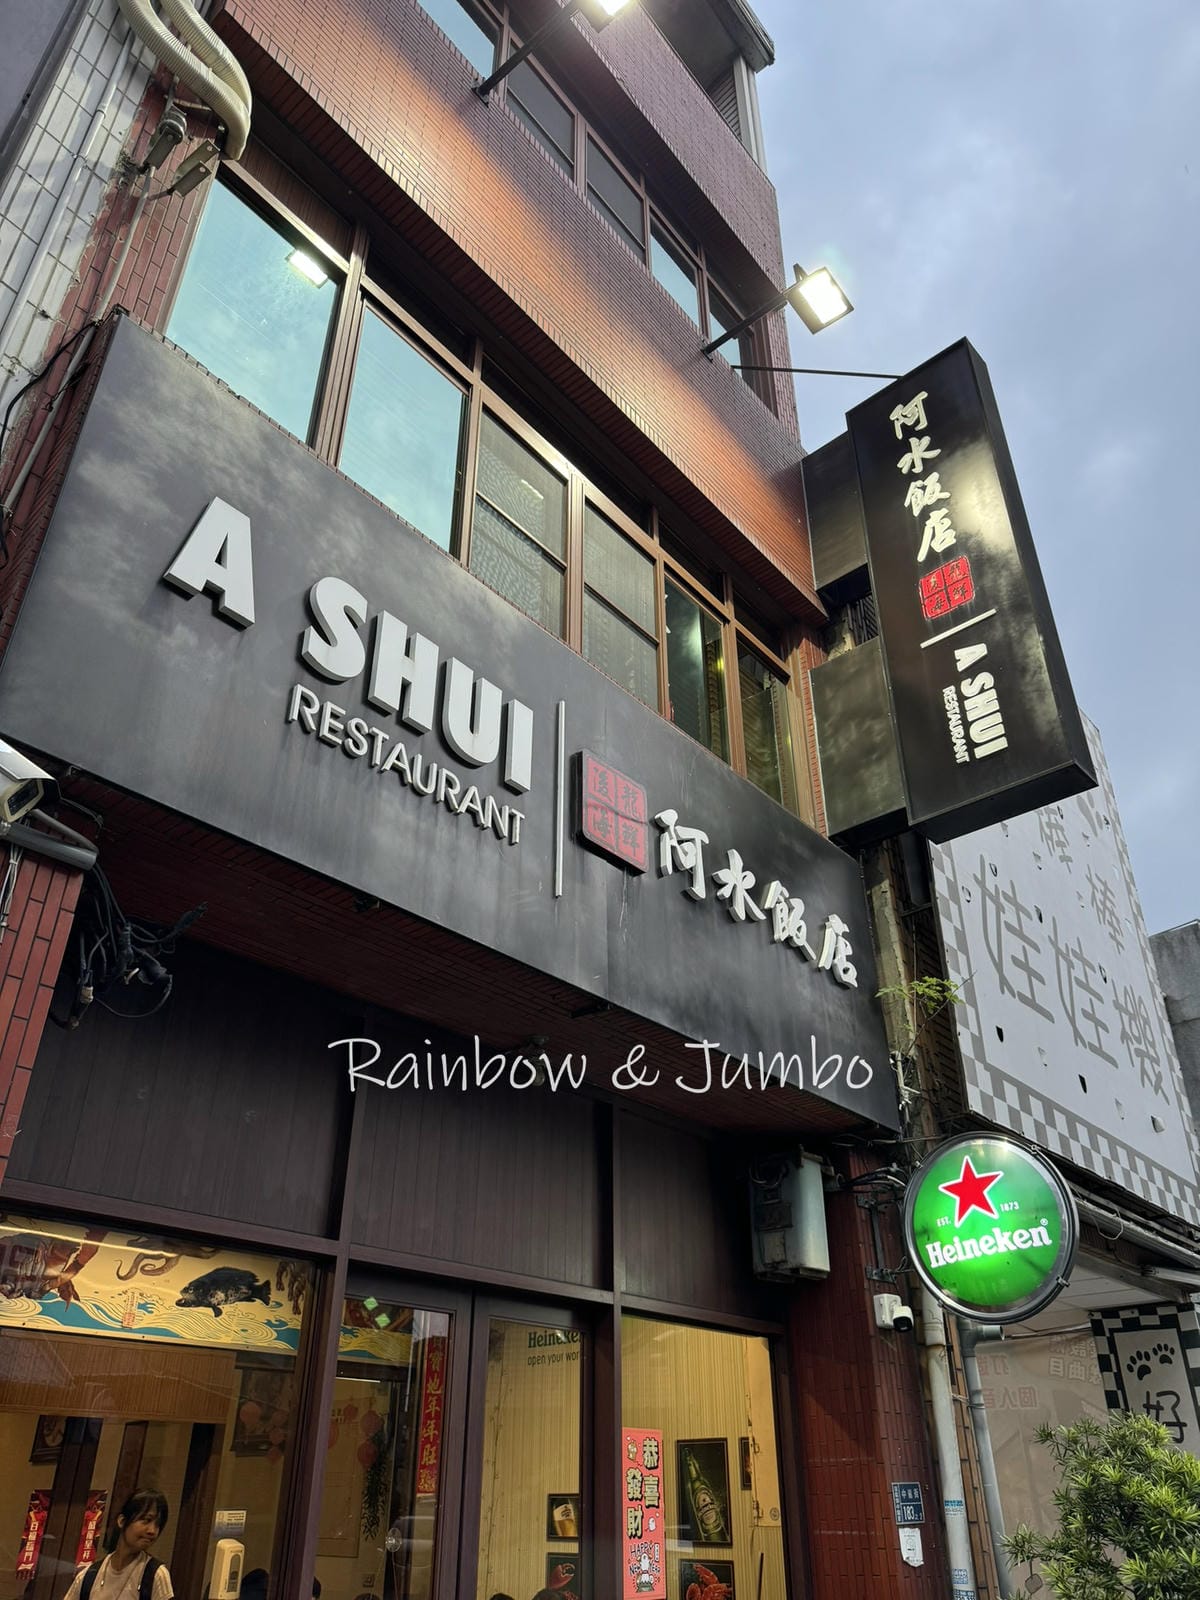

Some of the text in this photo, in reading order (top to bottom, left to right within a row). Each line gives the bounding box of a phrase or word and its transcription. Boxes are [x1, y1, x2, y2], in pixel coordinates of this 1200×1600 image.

[890, 391, 957, 562] 阿水飯店
[163, 497, 534, 793] A SHUI
[942, 686, 970, 765] RESTAURANT
[955, 643, 1008, 759] A SHUI
[288, 684, 525, 845] RESTAURANT
[655, 808, 858, 988] 阿水飯店
[926, 1226, 1052, 1268] Heineken
[936, 1201, 1019, 1227] EST. 1873
[528, 1355, 546, 1367] open
[626, 1467, 643, 1539] 發財
[643, 1438, 660, 1508] 恭喜
